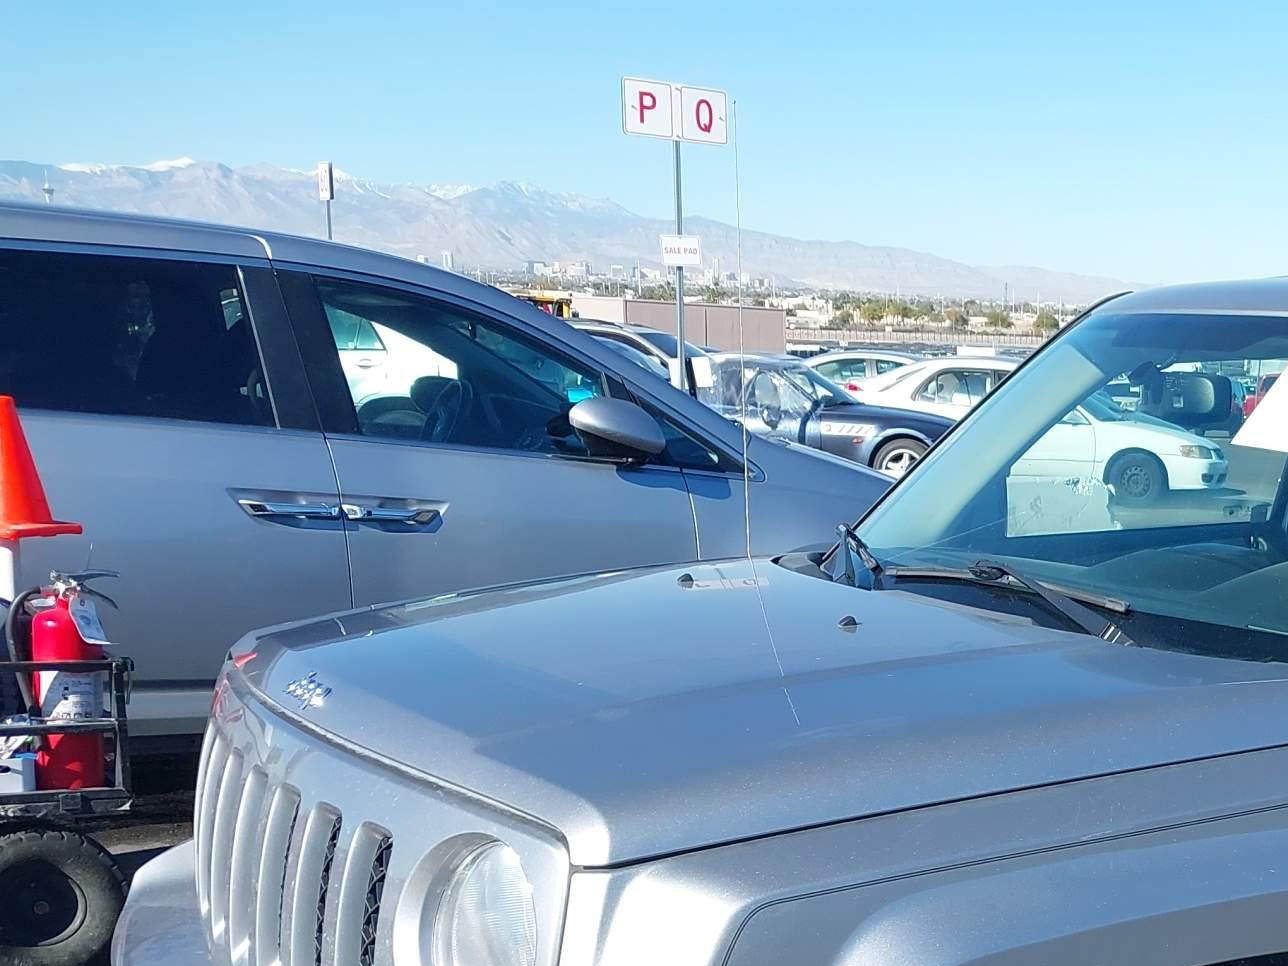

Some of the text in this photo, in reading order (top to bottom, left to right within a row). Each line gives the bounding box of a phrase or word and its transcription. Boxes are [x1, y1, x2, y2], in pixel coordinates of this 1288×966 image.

[638, 91, 657, 124] P
[695, 99, 713, 133] Q
[664, 246, 682, 255] SALE
